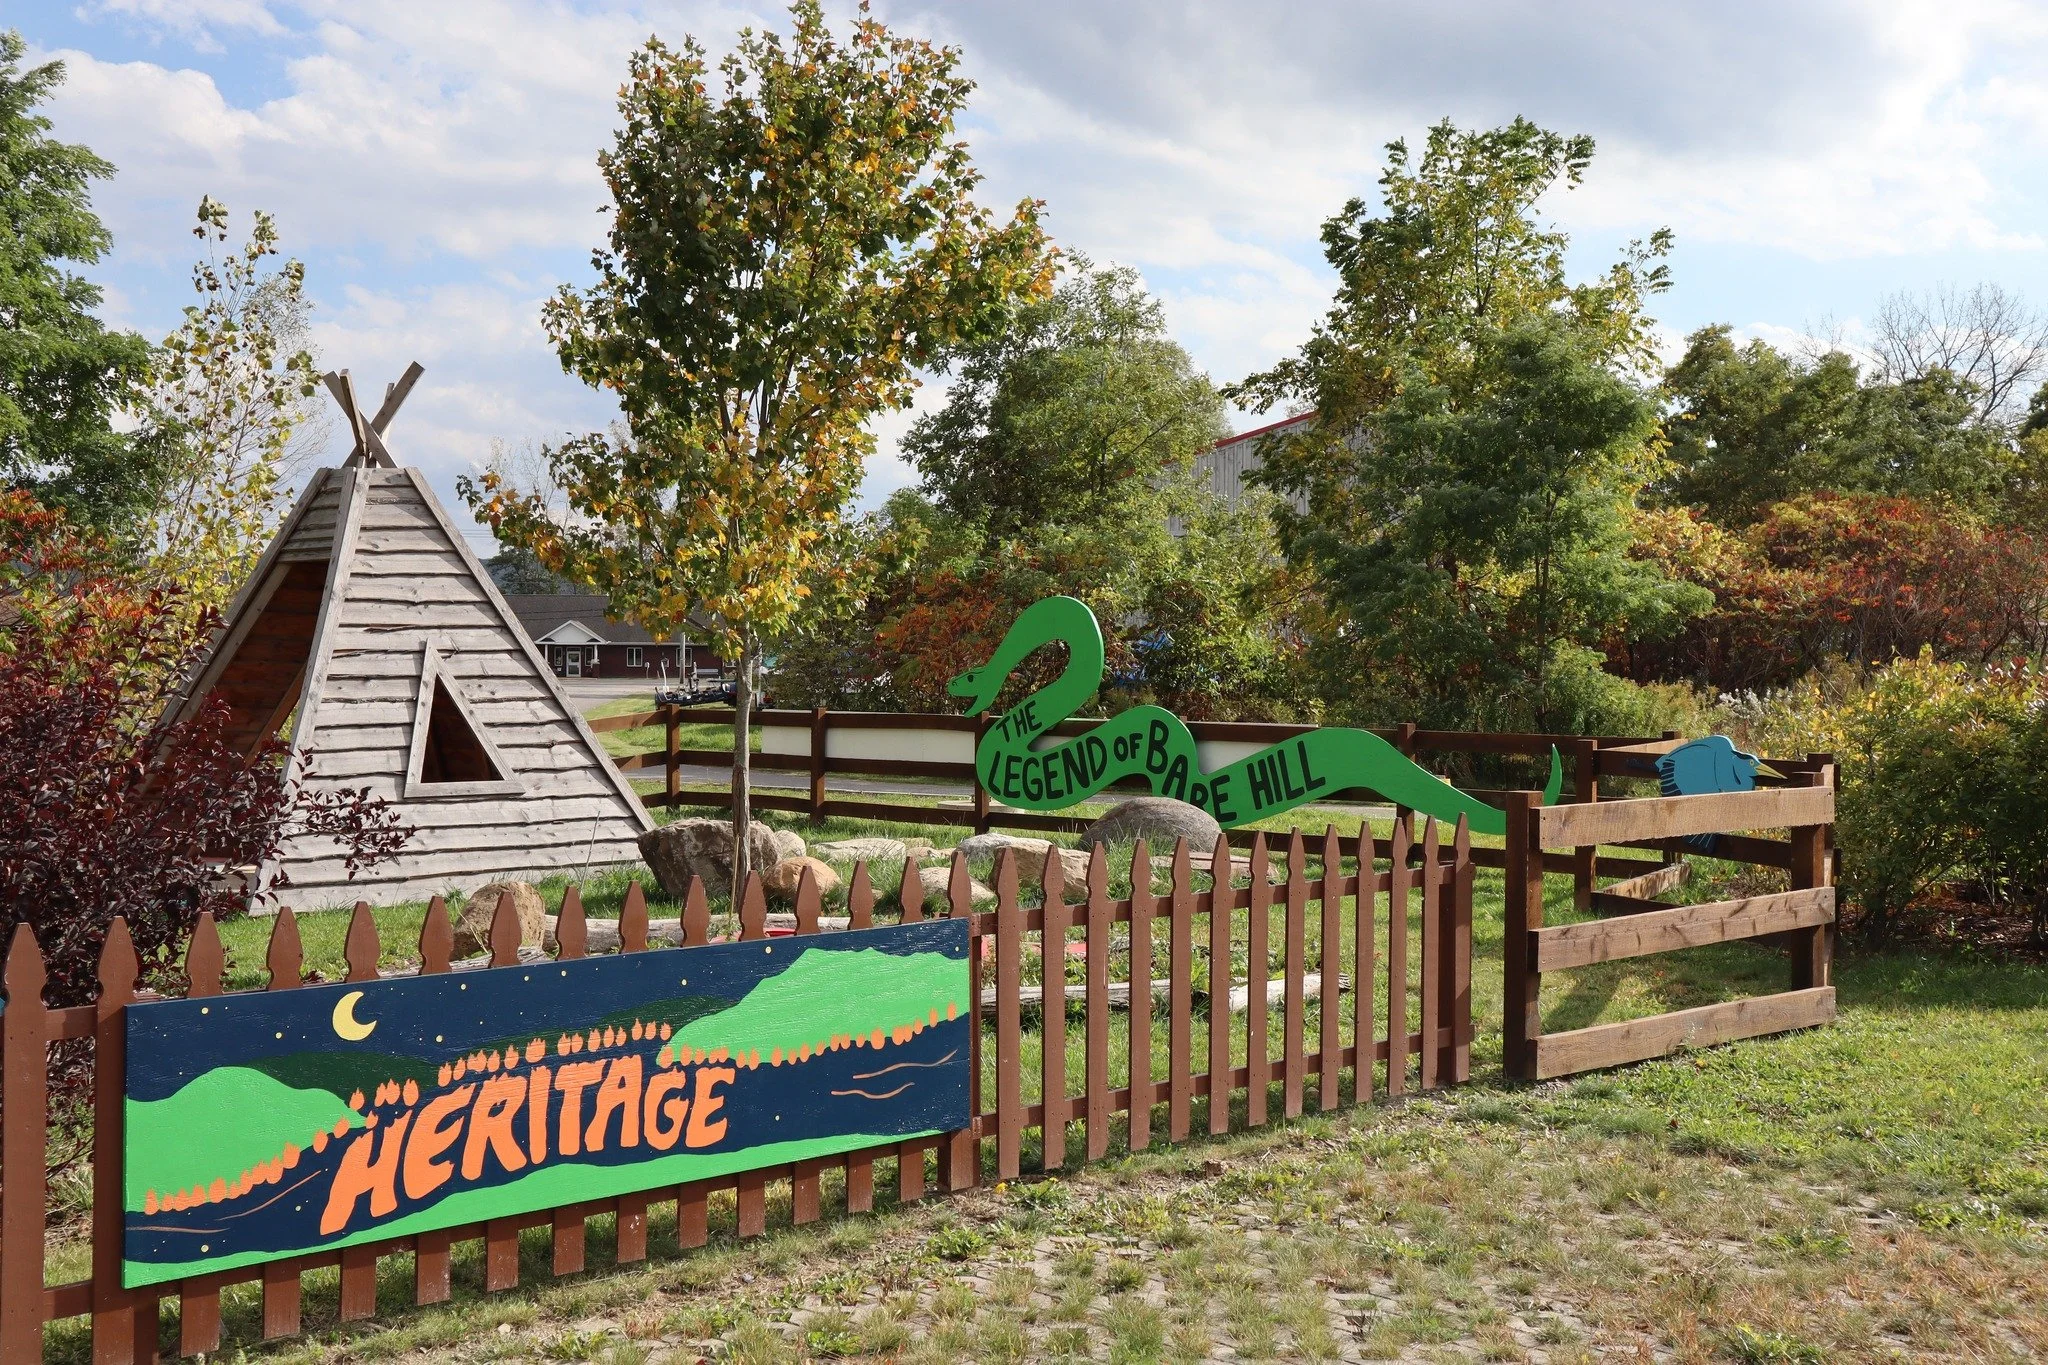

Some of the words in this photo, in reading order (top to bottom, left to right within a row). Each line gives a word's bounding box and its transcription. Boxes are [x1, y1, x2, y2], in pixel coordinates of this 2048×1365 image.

[988, 736, 1107, 801] LEGEND
[1146, 719, 1237, 823] BARE
[1246, 740, 1326, 810] HILL
[996, 700, 1042, 742] THE
[319, 1054, 736, 1236] HERITAGE
